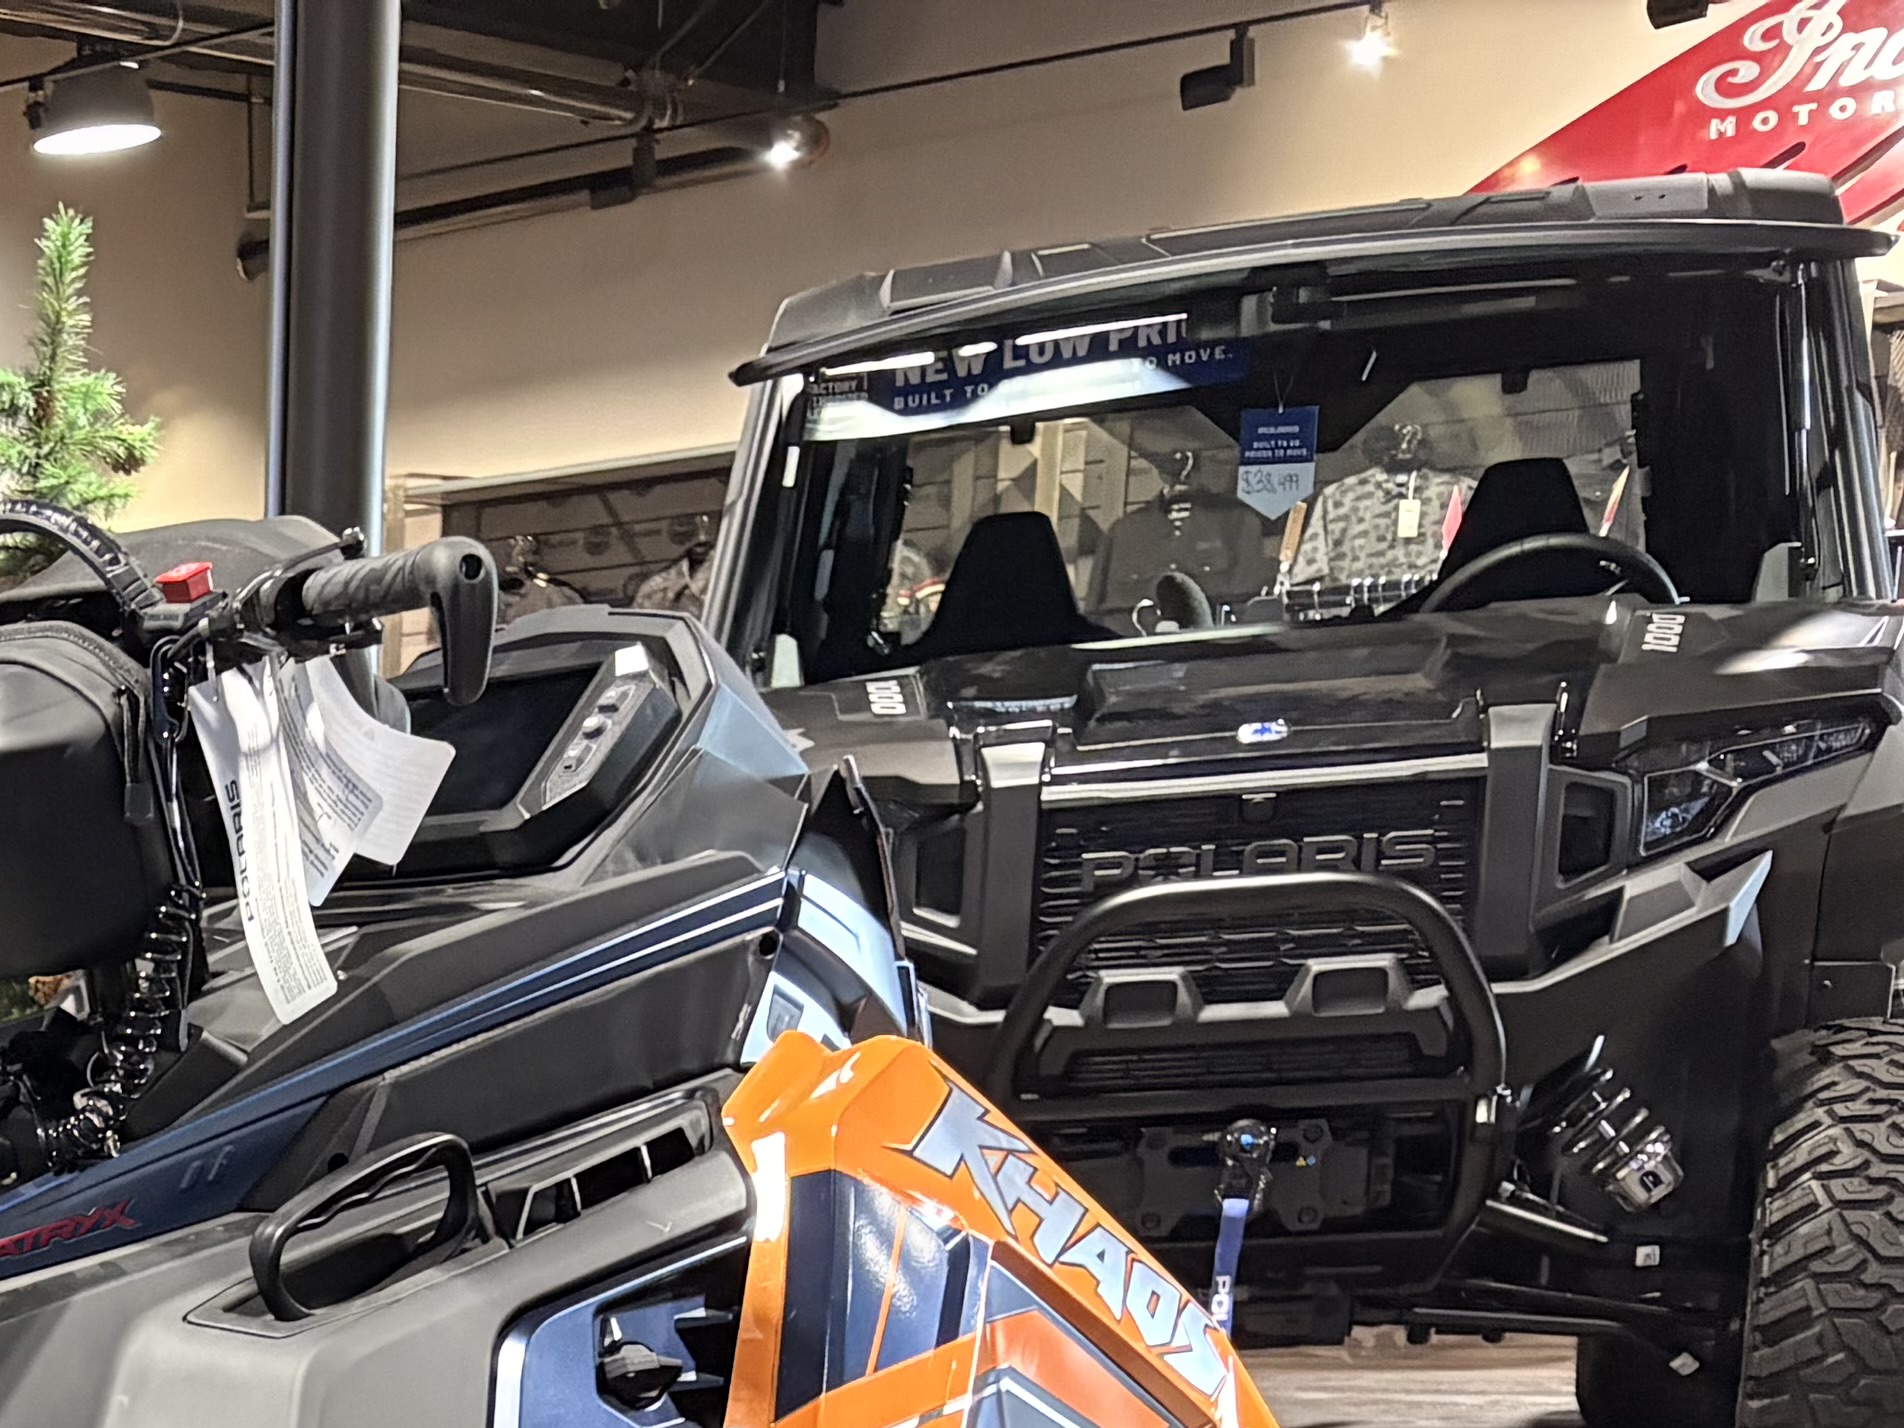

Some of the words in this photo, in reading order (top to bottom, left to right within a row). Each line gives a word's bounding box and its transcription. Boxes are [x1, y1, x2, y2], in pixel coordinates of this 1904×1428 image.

[893, 388, 953, 411] BUILT
[963, 382, 989, 399] TO
[1167, 346, 1232, 368] MOVE.
[1640, 612, 1686, 653] 1000
[223, 778, 255, 923] POLARIS
[1080, 829, 1436, 892] POLARIS
[911, 1079, 1228, 1397] KHAOS
